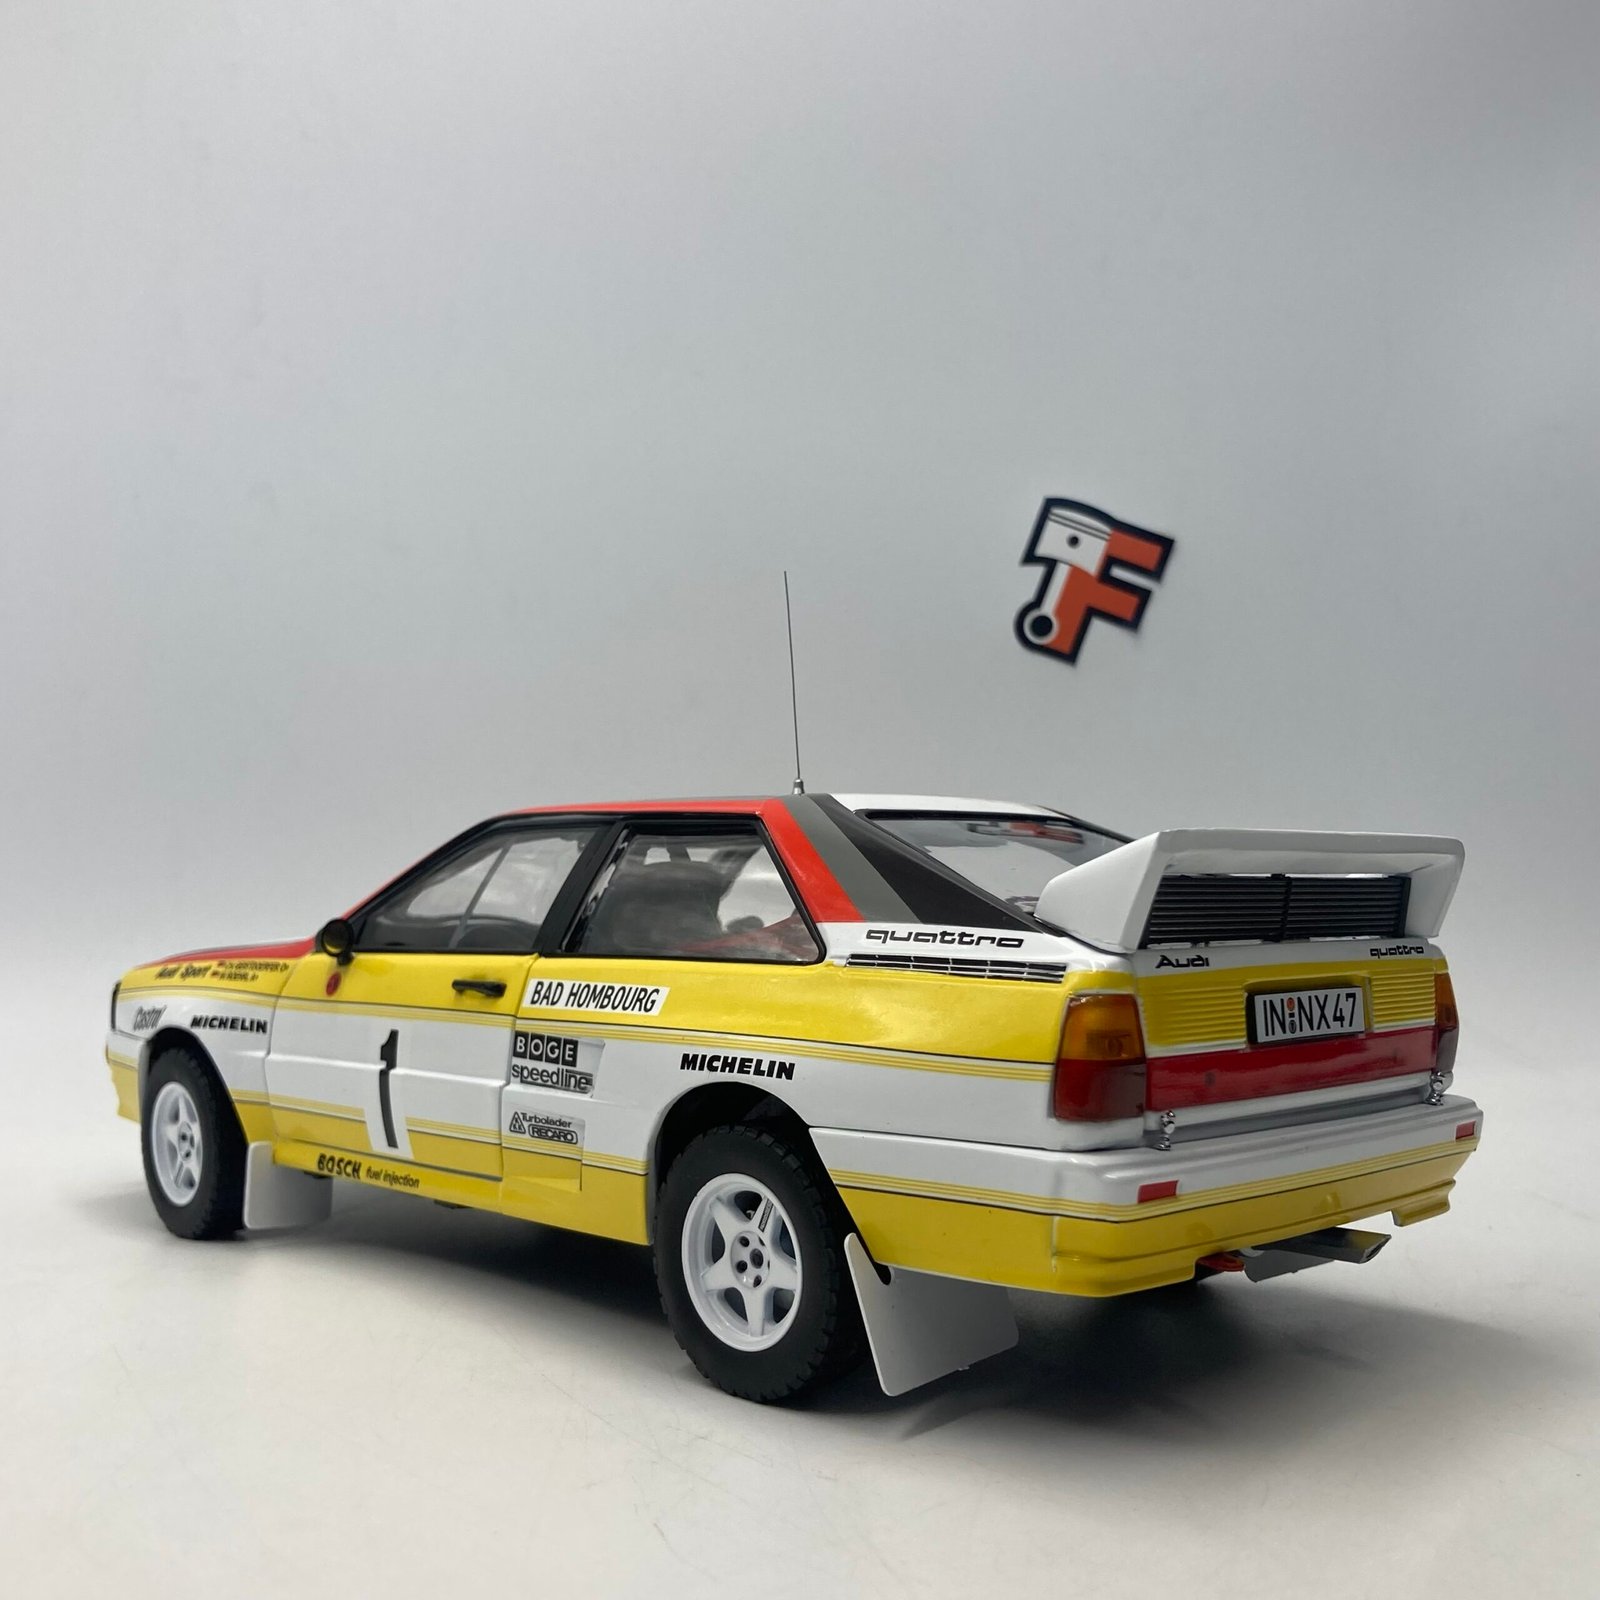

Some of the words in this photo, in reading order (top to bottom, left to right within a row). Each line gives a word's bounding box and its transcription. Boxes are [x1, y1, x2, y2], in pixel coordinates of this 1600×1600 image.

[865, 928, 1024, 948] quattro
[1155, 954, 1210, 969] Audi
[1369, 945, 1425, 959] quattro
[530, 980, 563, 1006] BAD
[566, 982, 660, 1013] HOMBOURG
[190, 1014, 268, 1034] MICHELIN
[514, 1033, 577, 1064] BOGE
[511, 1062, 593, 1092] speedline
[679, 1053, 796, 1081] MICHELIN
[379, 1028, 399, 1149] 1
[520, 1111, 572, 1129] Turbolader
[531, 1126, 574, 1142] RECARO
[317, 1153, 362, 1180] BOSCH
[366, 1165, 382, 1179] fuel
[383, 1168, 420, 1189] injection
